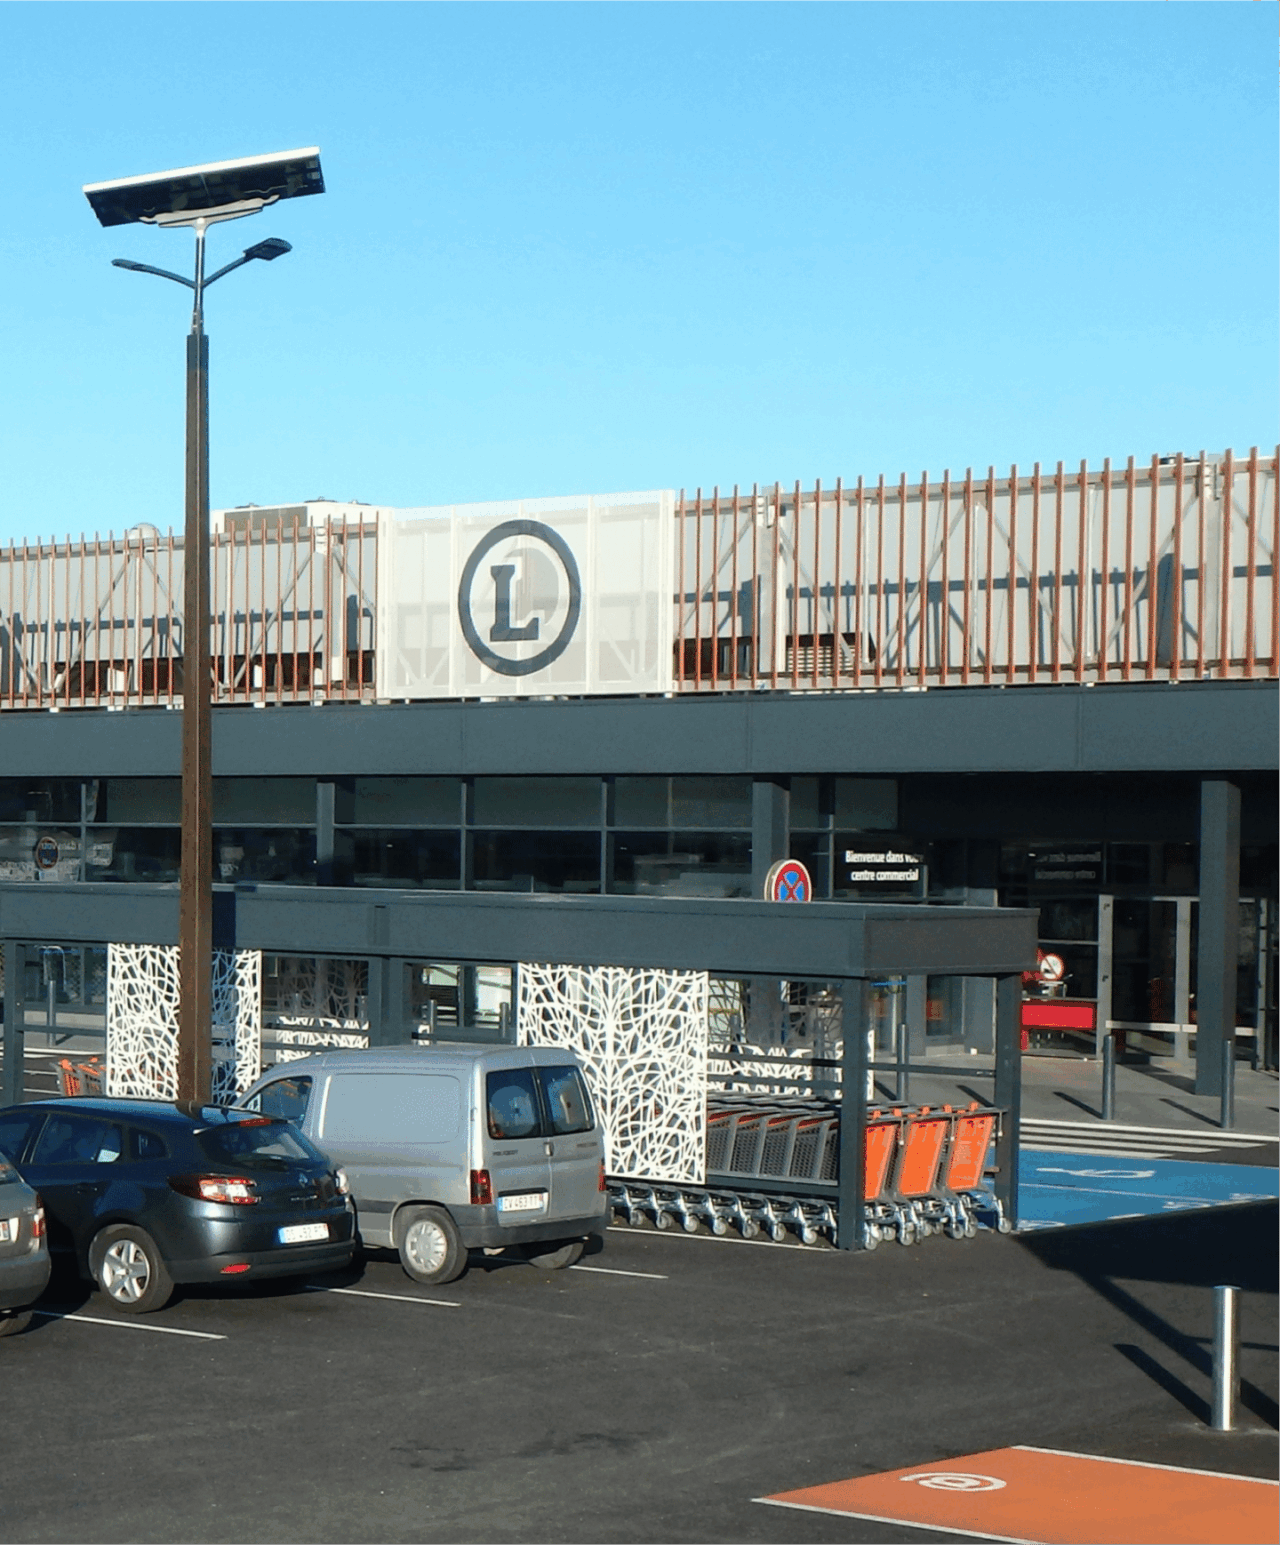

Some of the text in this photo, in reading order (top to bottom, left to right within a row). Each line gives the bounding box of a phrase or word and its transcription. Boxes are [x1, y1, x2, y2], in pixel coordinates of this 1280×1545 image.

[845, 849, 886, 863] Bienvenue
[886, 850, 904, 863] dans
[851, 868, 919, 881] centre commercial
